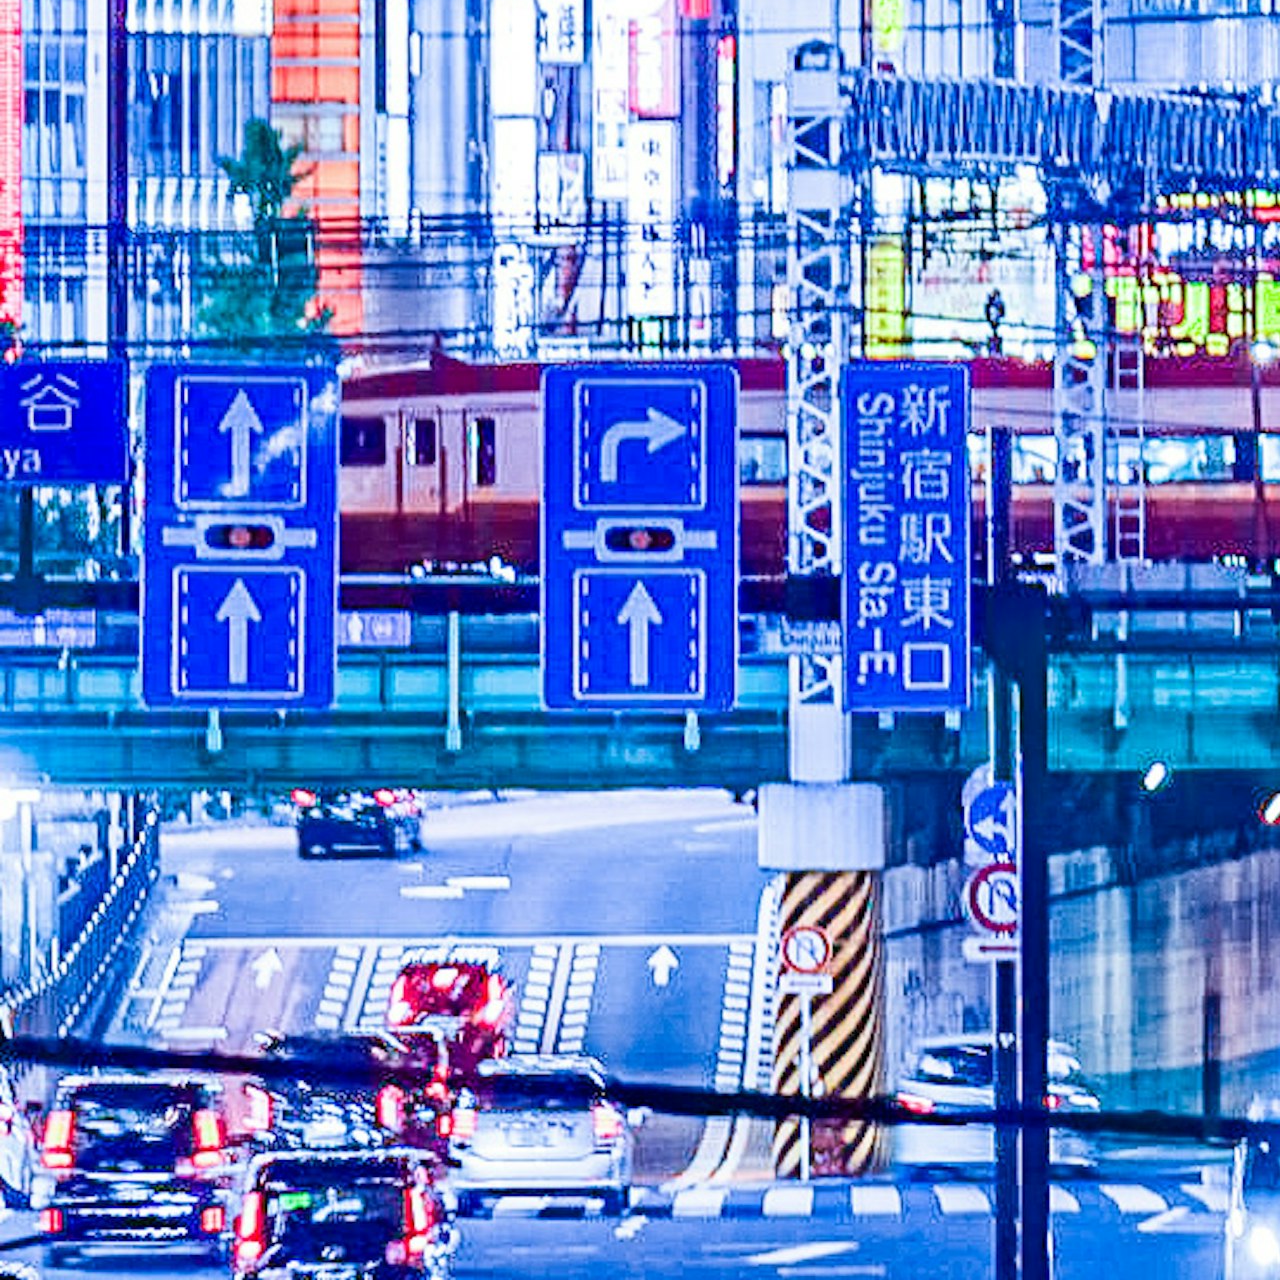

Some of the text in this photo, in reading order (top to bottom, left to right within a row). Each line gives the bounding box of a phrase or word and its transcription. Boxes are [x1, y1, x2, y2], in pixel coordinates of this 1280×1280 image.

[20, 372, 80, 432] 谷
[3, 448, 41, 480] ya
[851, 391, 895, 546] Shinjuku
[899, 383, 953, 690] 新宿駅東口
